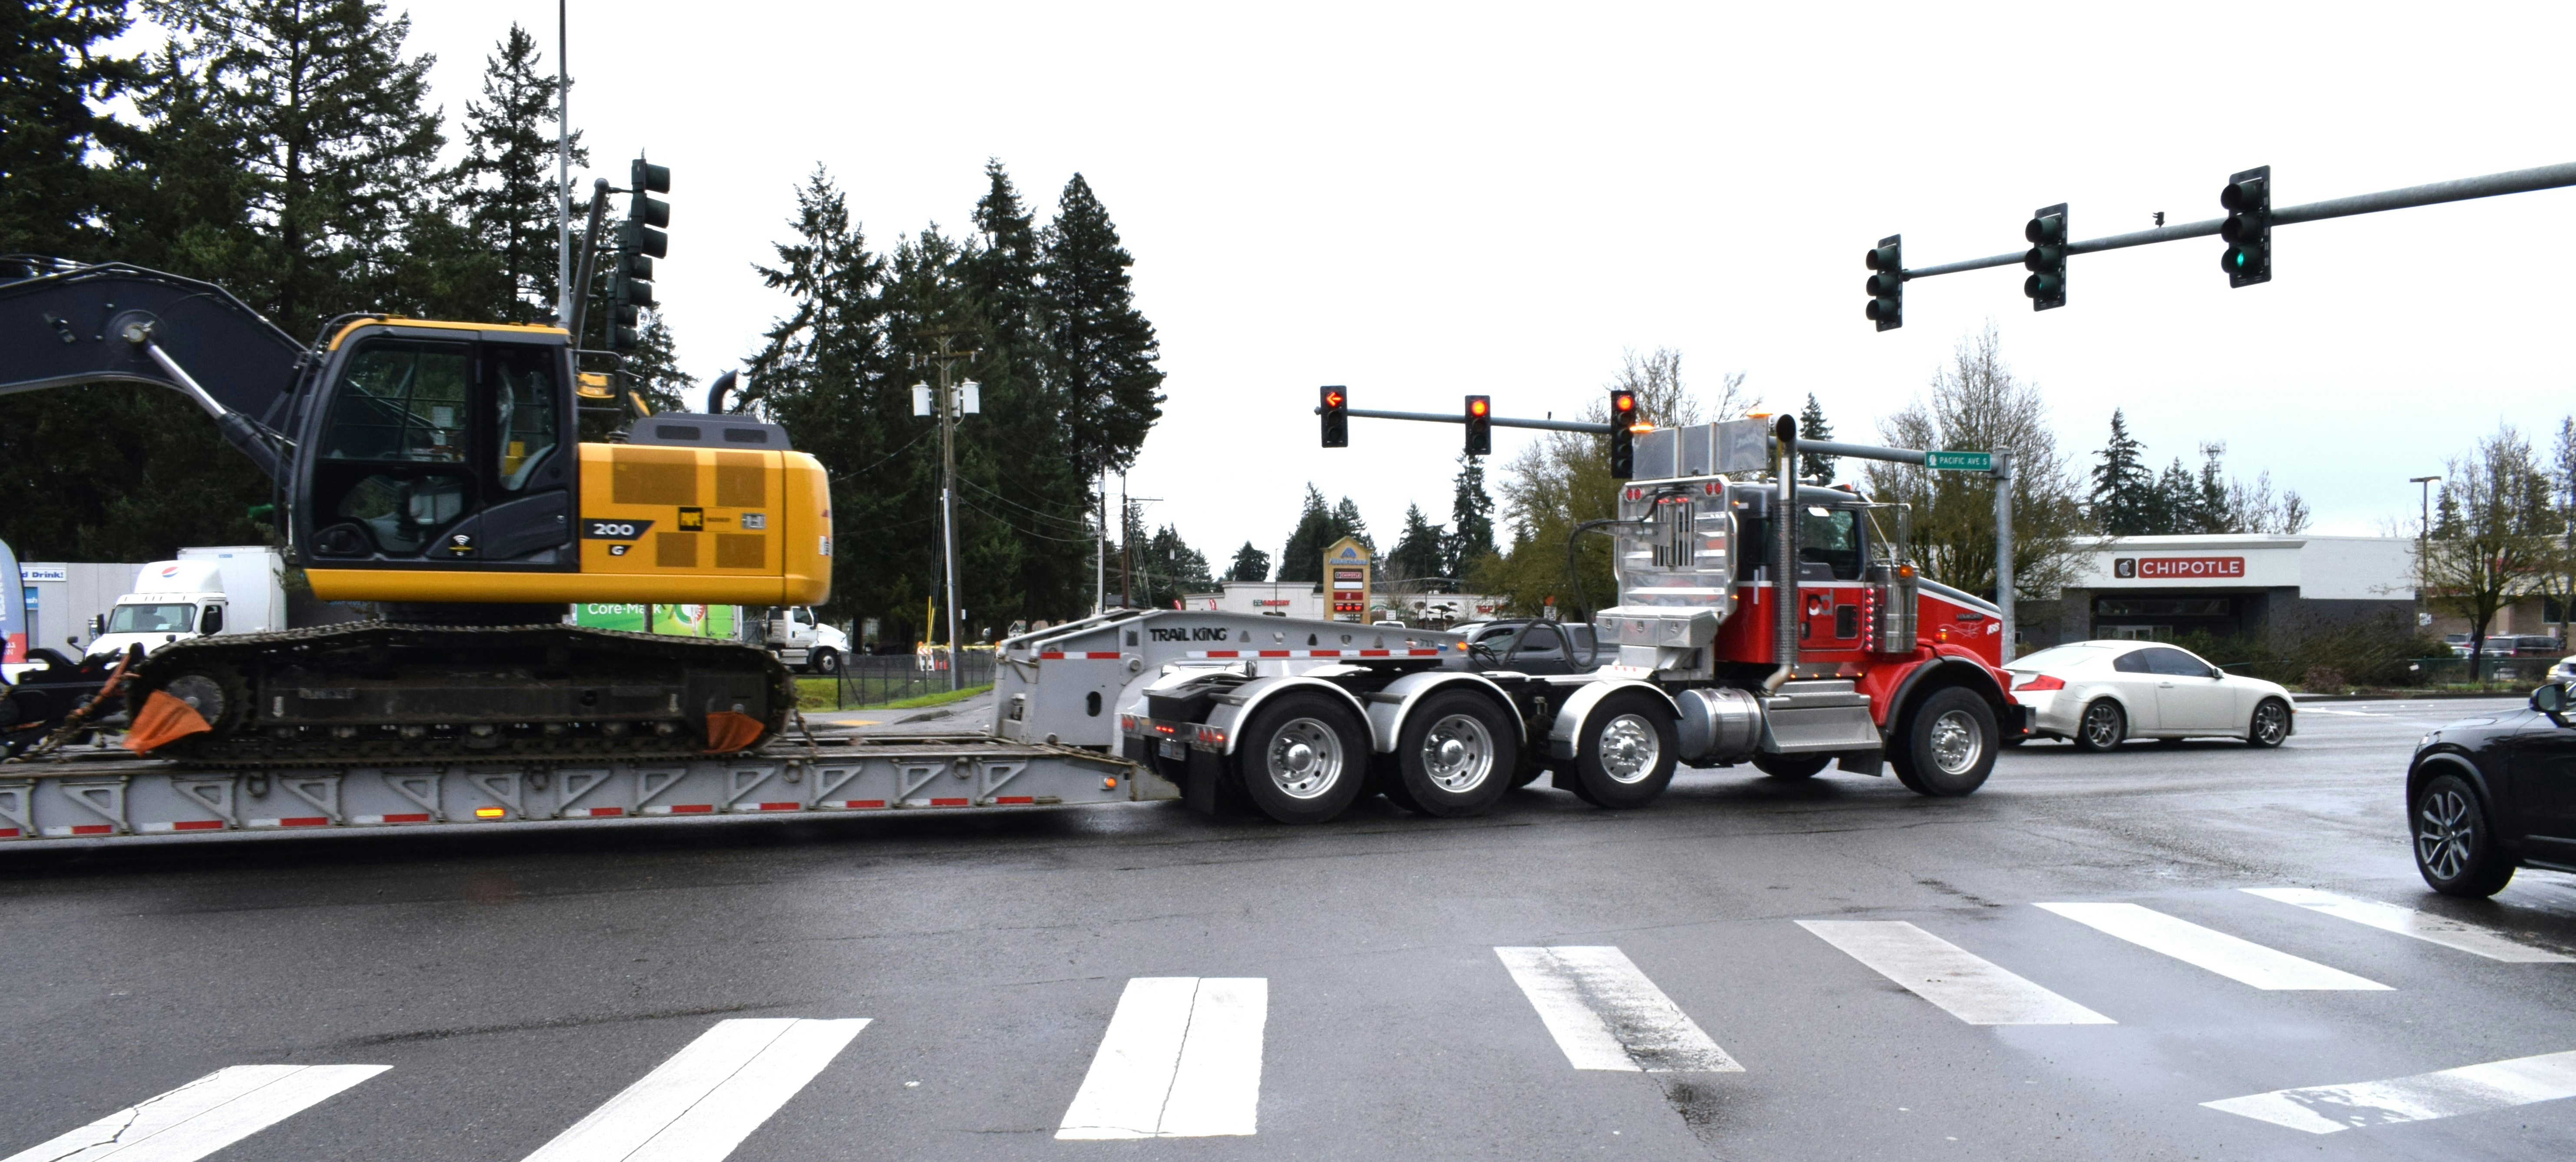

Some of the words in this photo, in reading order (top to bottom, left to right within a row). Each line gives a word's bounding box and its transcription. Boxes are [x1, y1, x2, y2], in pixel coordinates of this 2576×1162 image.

[593, 523, 635, 535] 200
[611, 546, 624, 555] G
[2142, 561, 2240, 574] CHIPOTLE
[587, 603, 661, 614] Core-Mak
